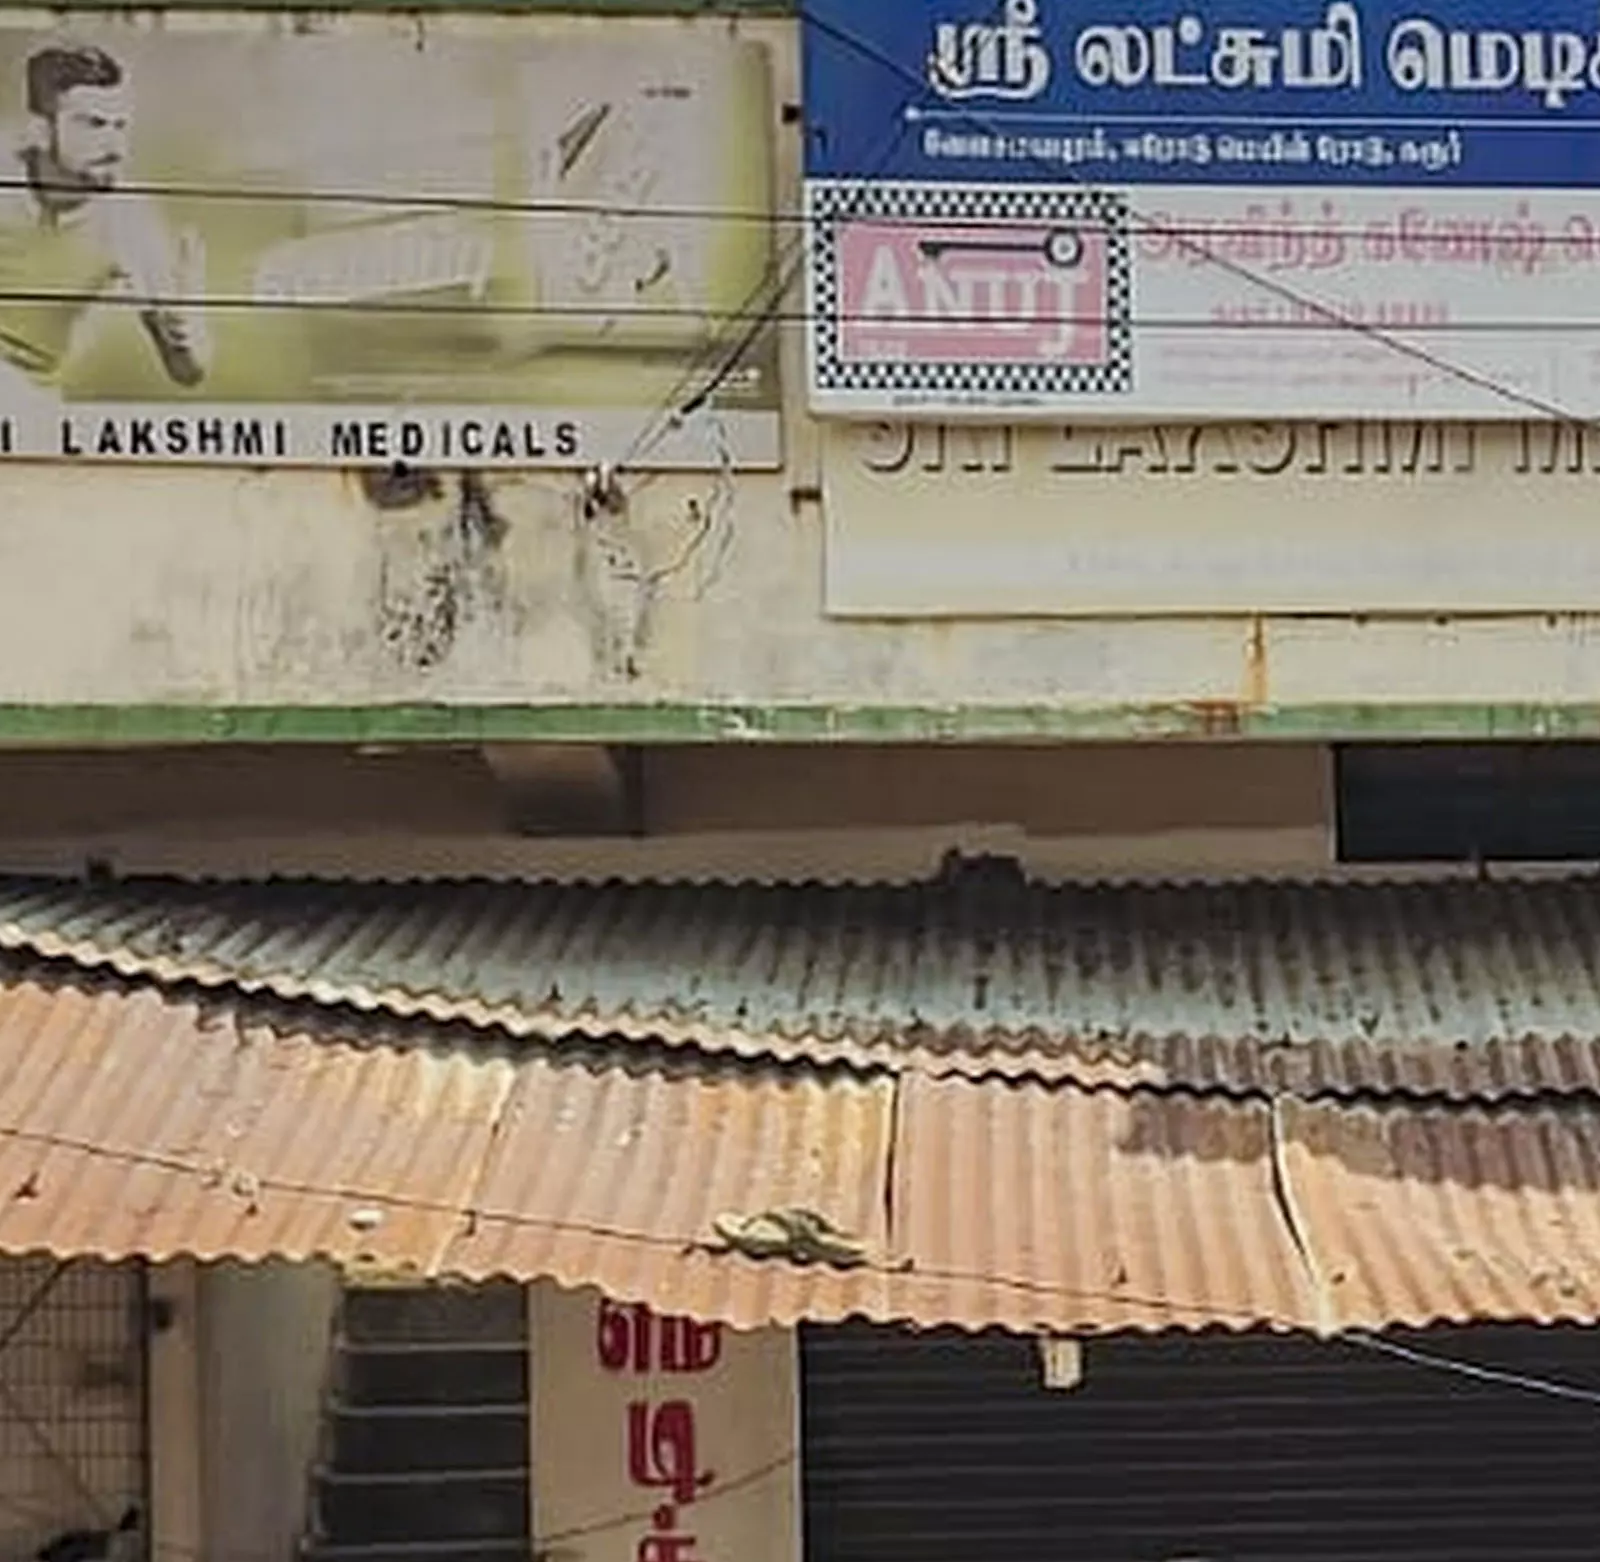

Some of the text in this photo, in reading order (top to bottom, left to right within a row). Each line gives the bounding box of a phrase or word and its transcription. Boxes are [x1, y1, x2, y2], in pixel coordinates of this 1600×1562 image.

[1075, 2, 1362, 90] லட்சுமி
[61, 419, 288, 457] LAKSHMI
[331, 420, 580, 459] MEDICALS
